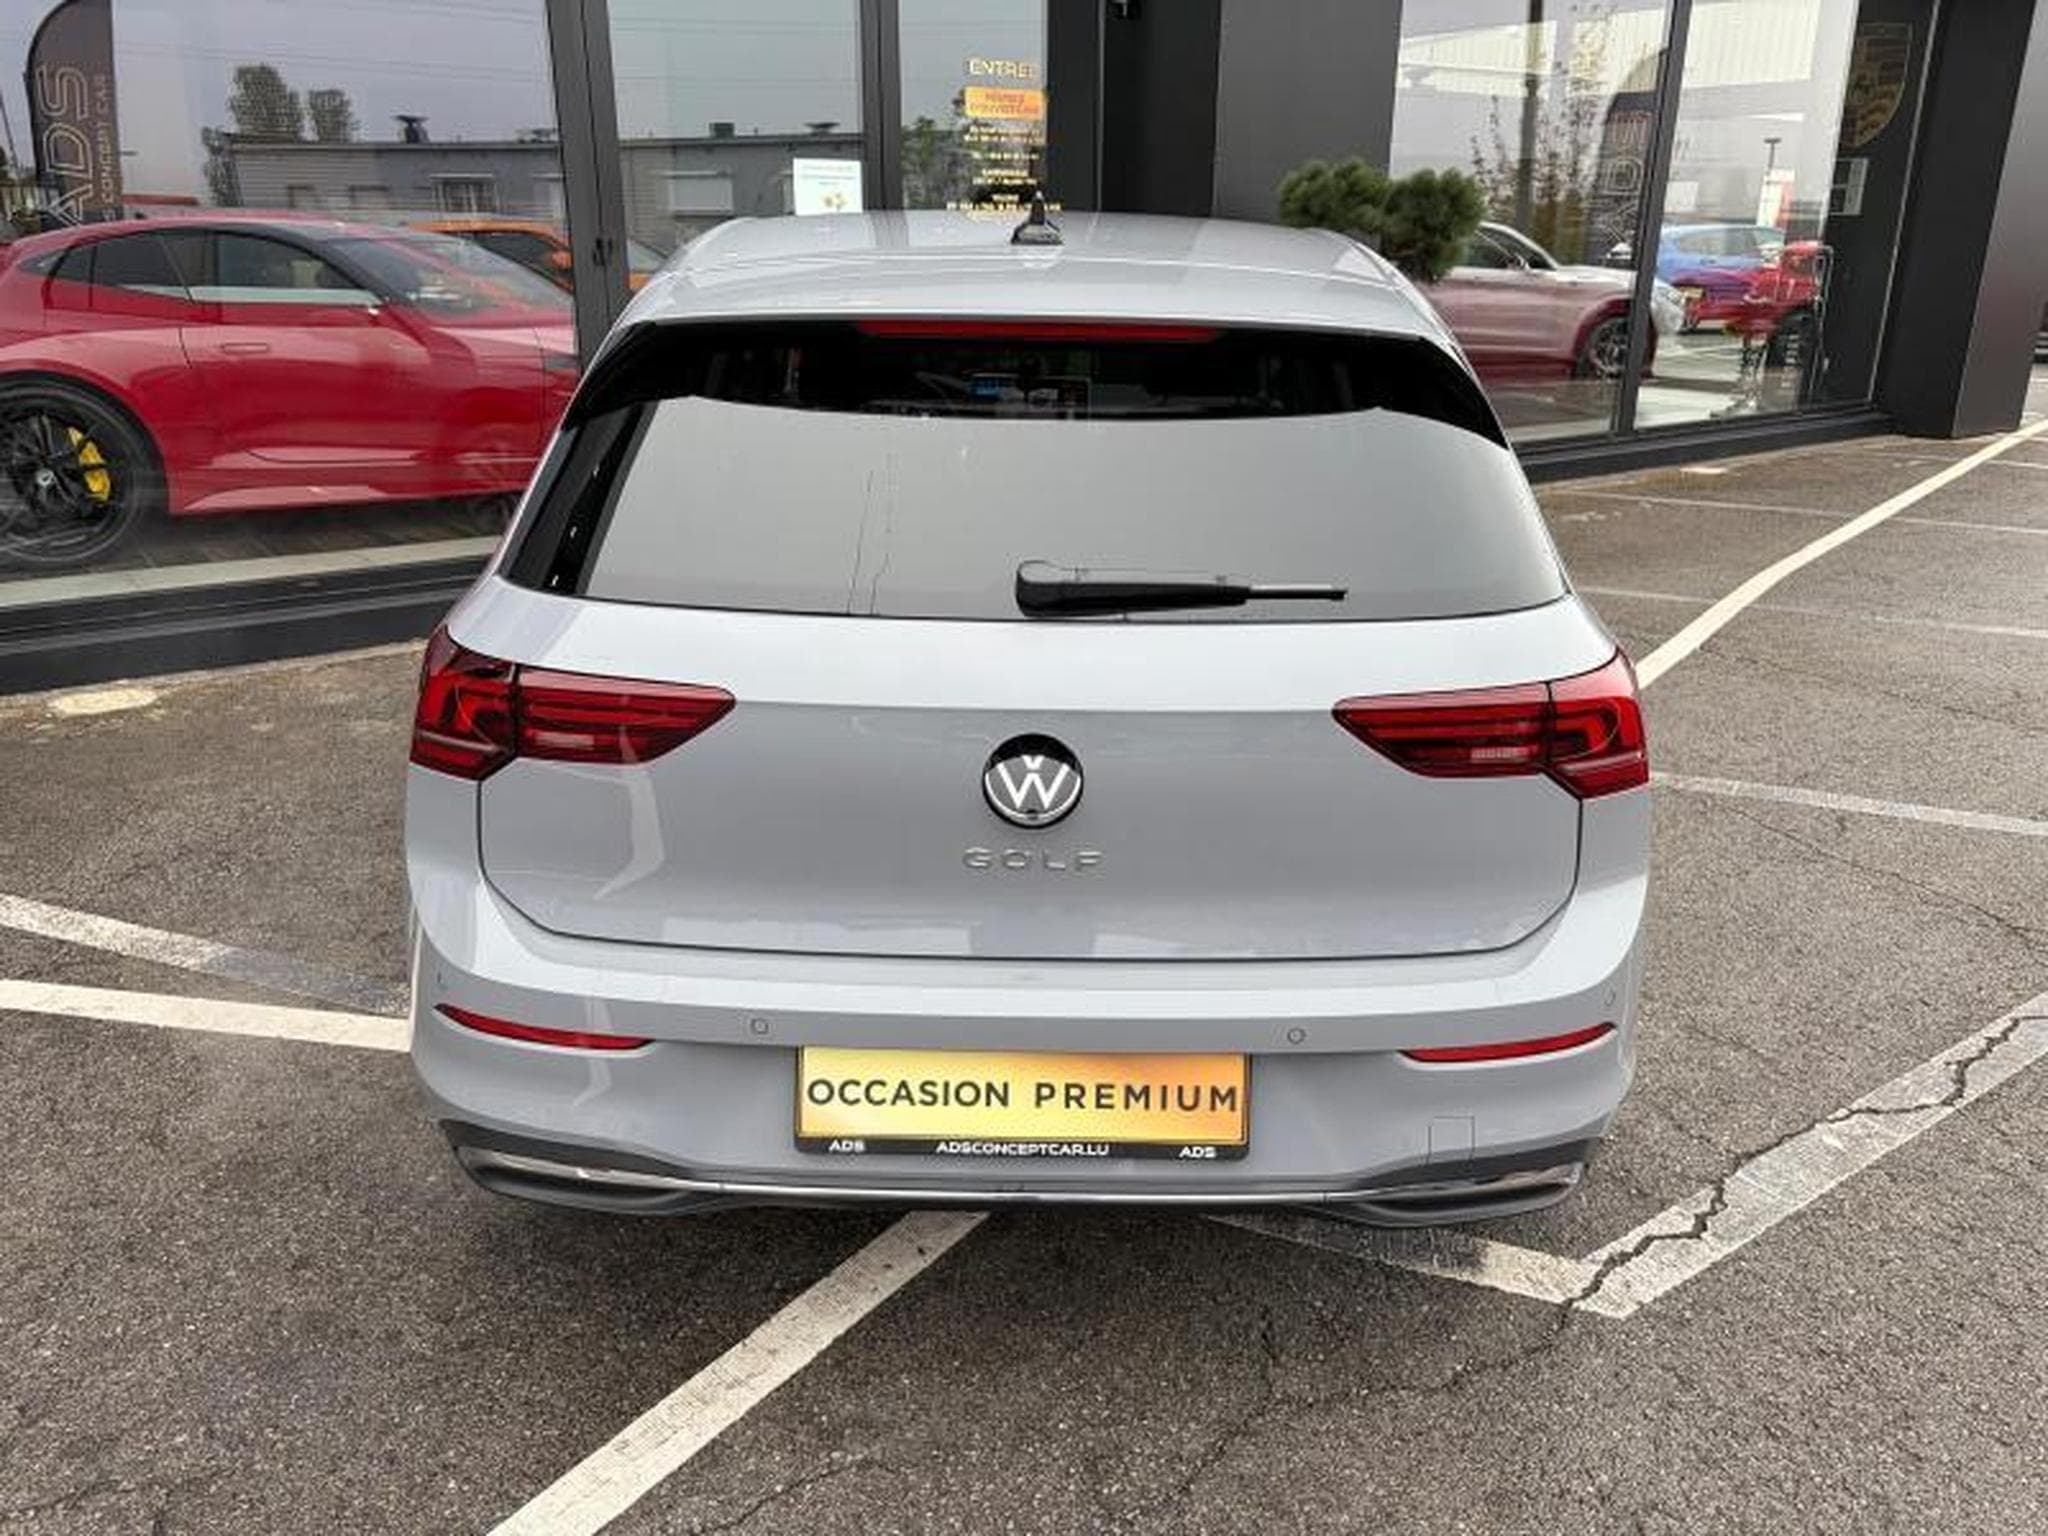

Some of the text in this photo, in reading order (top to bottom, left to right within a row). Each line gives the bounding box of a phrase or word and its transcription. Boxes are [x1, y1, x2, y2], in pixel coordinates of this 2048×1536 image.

[36, 65, 94, 228] ADS
[962, 847, 1101, 871] GOLF
[807, 1079, 1237, 1112] OCCASION PREMIUM
[828, 1138, 866, 1152] ADS
[1178, 1145, 1217, 1159] ADS
